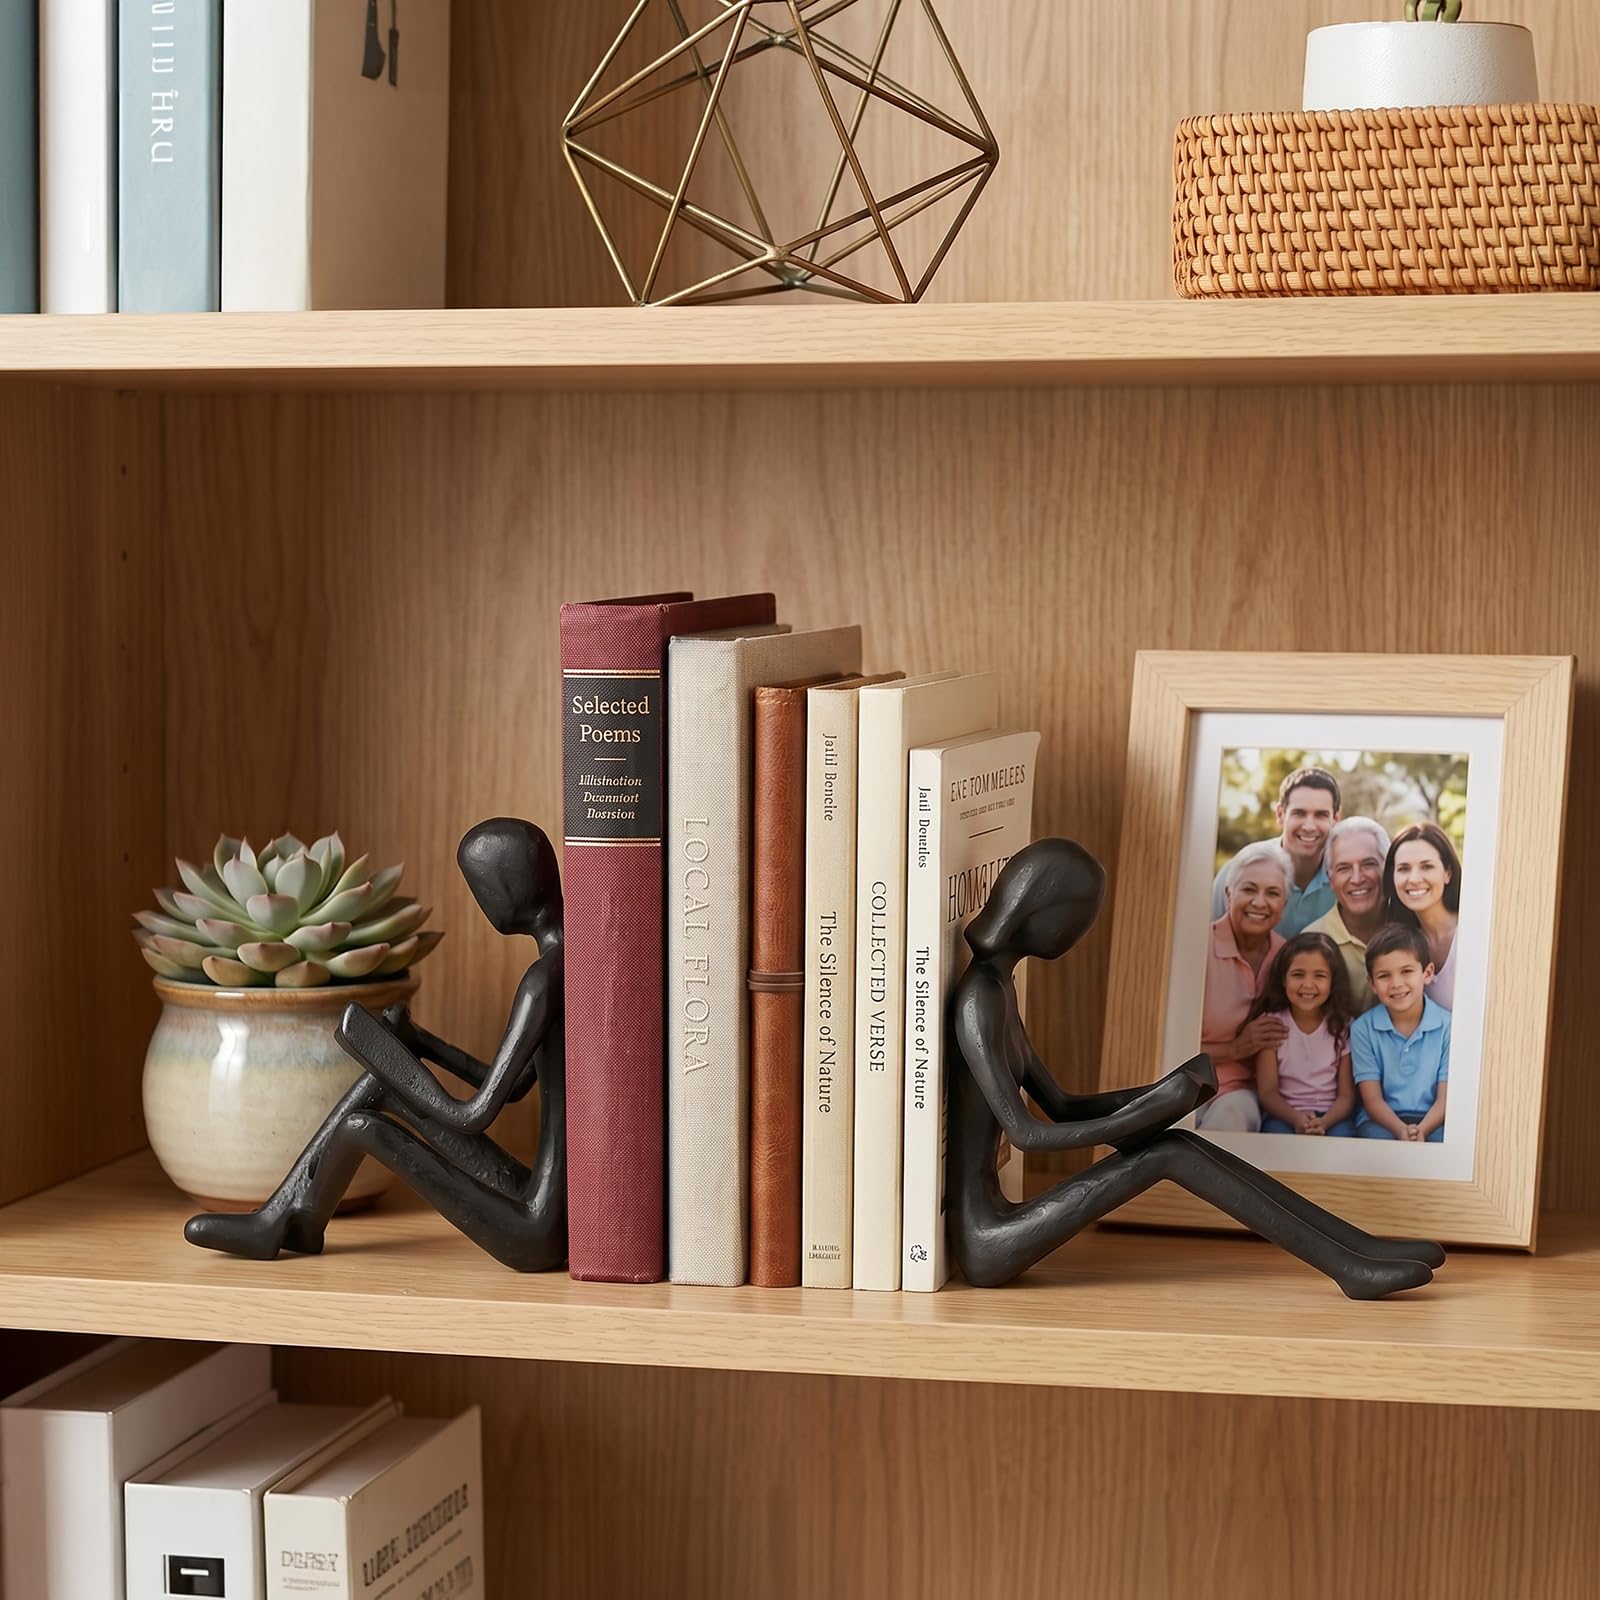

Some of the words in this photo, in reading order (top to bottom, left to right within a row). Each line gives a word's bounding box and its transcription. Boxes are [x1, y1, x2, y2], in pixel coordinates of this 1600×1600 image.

[572, 695, 650, 715] Selected
[579, 724, 641, 743] Poems
[683, 817, 710, 939] LOCAL
[820, 911, 838, 946] The
[870, 881, 887, 1003] COLLECTED
[819, 952, 838, 1019] Silence
[915, 946, 930, 975] The
[683, 953, 710, 1075] FLORA
[915, 980, 930, 1033] Silence
[819, 1025, 837, 1046] of
[869, 1010, 886, 1072] VERSE
[915, 1038, 929, 1054] of
[818, 1051, 836, 1114] Nature
[914, 1058, 929, 1110] Nature
